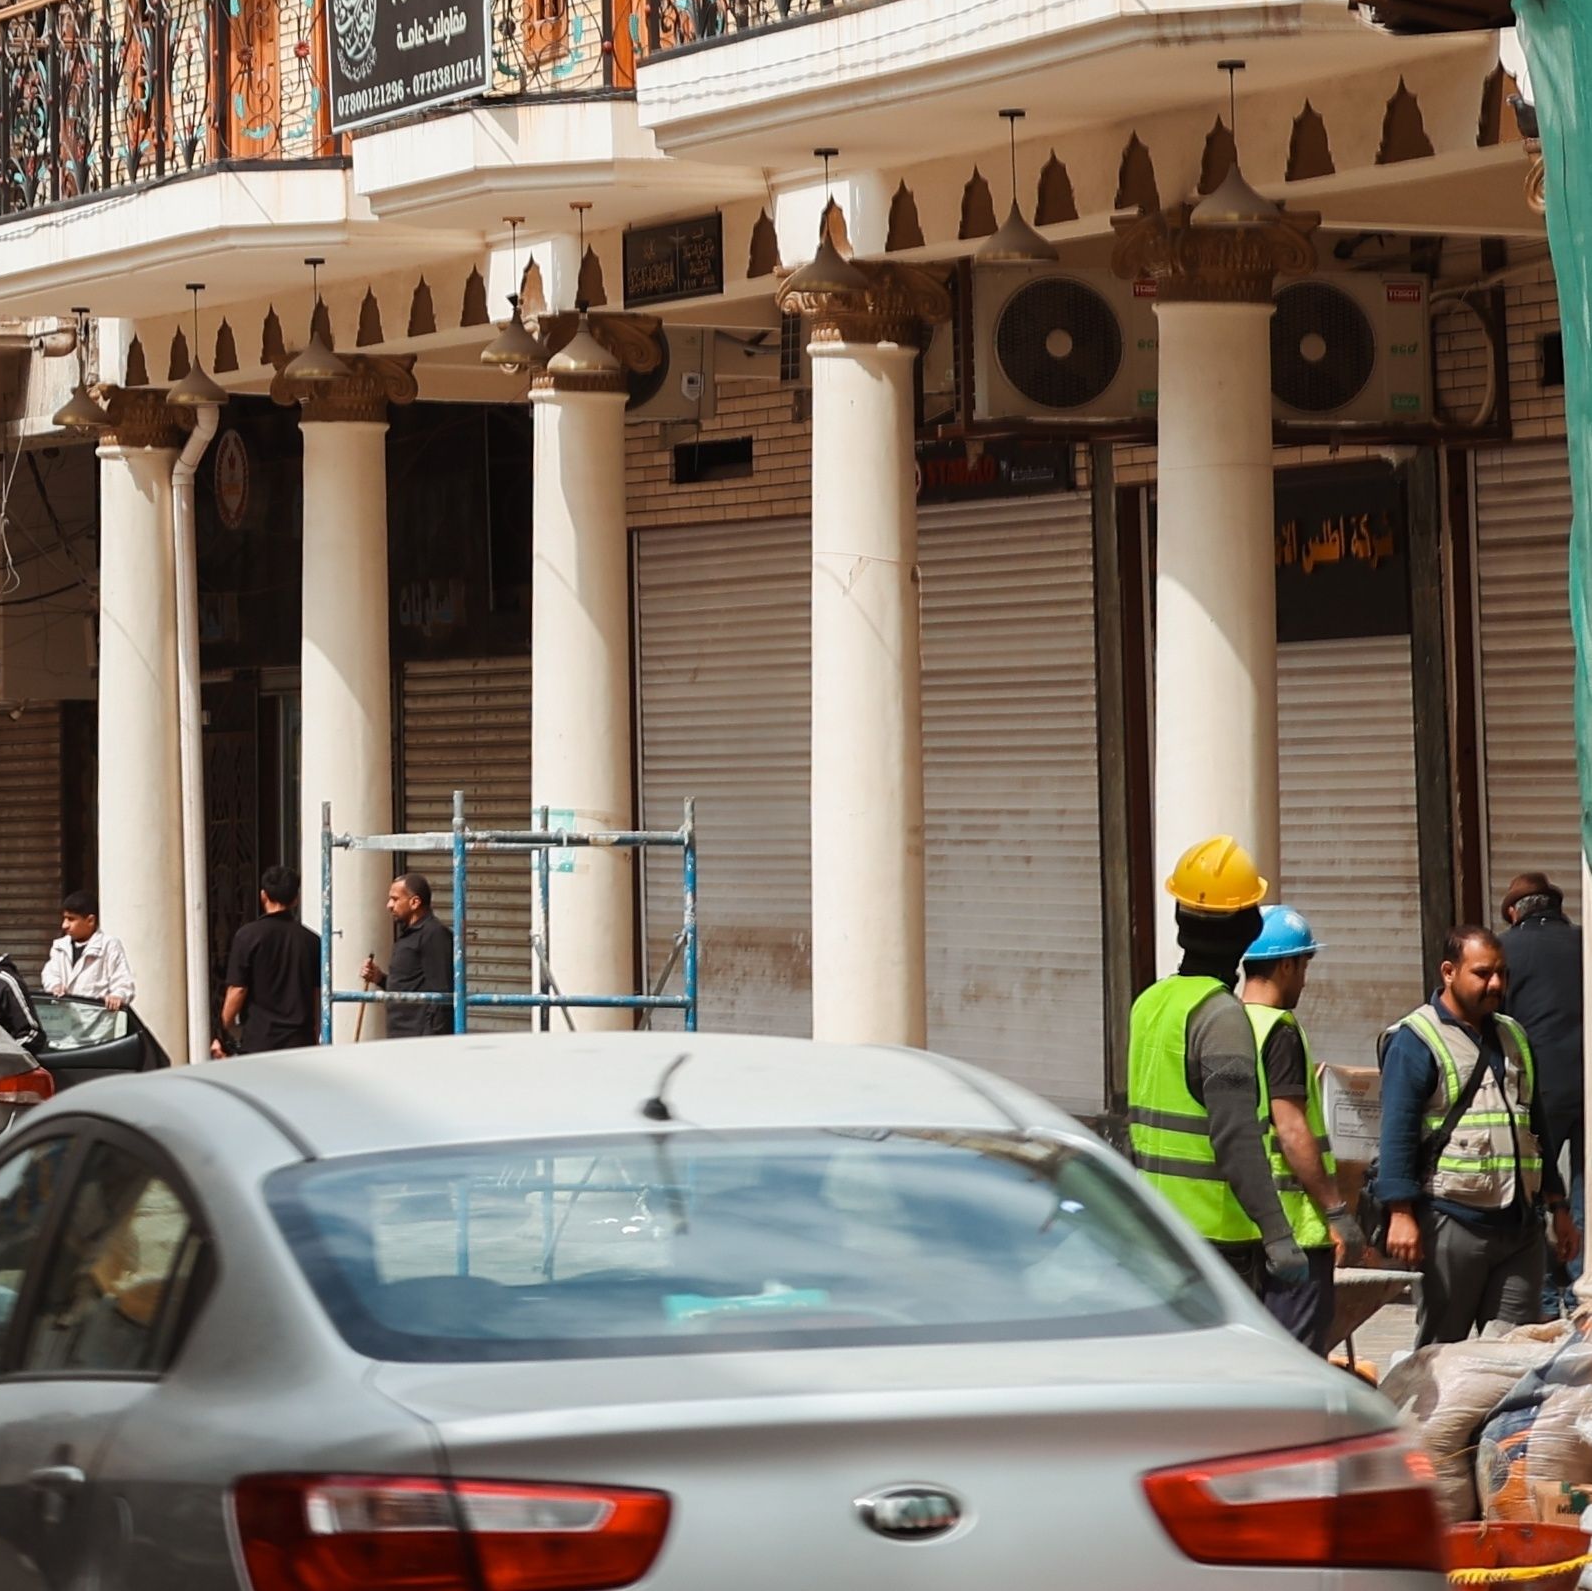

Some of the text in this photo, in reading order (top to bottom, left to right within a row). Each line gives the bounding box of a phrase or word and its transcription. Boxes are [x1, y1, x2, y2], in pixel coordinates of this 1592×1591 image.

[396, 7, 467, 51] مقاولات عامة
[337, 80, 404, 117] 07800121296
[413, 55, 483, 97] 07733810714
